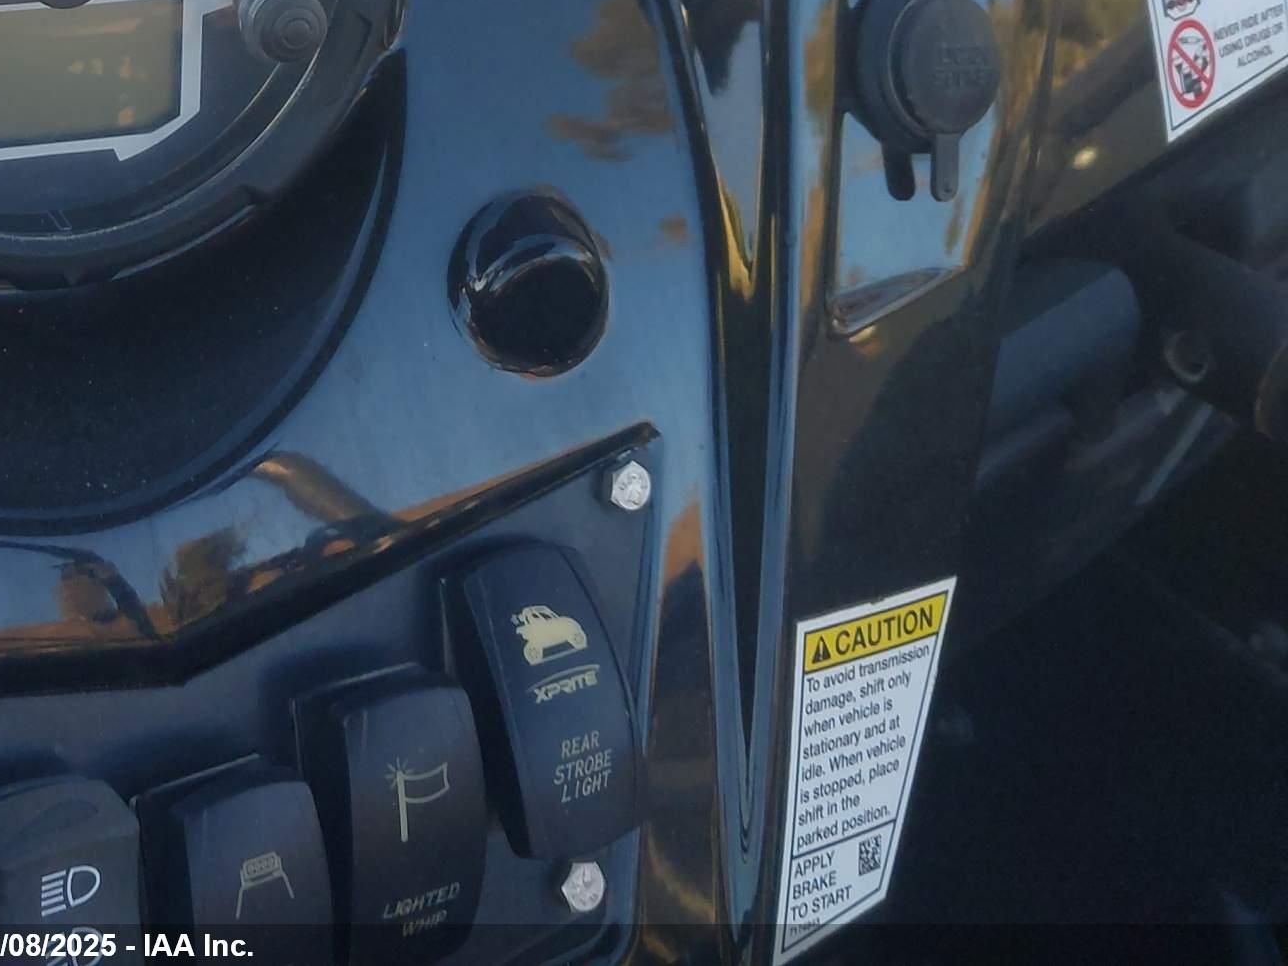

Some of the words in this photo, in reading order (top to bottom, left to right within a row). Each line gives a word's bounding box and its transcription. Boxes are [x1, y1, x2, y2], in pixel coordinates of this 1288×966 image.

[835, 604, 932, 655] CAUTION
[807, 677, 820, 693] To
[823, 666, 855, 689] avoid
[859, 644, 930, 677] transmission
[534, 671, 598, 704] XPRITE
[805, 690, 856, 716] damage,
[860, 677, 885, 698] shift
[888, 669, 911, 688] only
[804, 717, 835, 737] when
[839, 702, 880, 726] vehicle
[883, 697, 893, 712] is
[562, 730, 600, 759] REAR
[803, 730, 860, 760] stationary
[864, 719, 886, 739] and
[889, 715, 900, 731] at
[554, 748, 612, 785] STROBE
[801, 762, 826, 782] idle.
[829, 751, 863, 772] When
[866, 735, 906, 760] vehicle
[561, 769, 612, 803] LIGHT
[800, 789, 810, 804] is
[812, 770, 865, 799] stopped,
[868, 759, 900, 784] place
[796, 820, 838, 851] parked
[841, 805, 890, 836] position.
[798, 804, 824, 826] shift
[827, 801, 838, 816] in
[841, 795, 860, 811] the
[794, 850, 835, 879] APPLY
[383, 882, 461, 919] LIGHTED
[791, 902, 808, 921] TO
[812, 885, 852, 913] START
[793, 870, 837, 900] BRAKE
